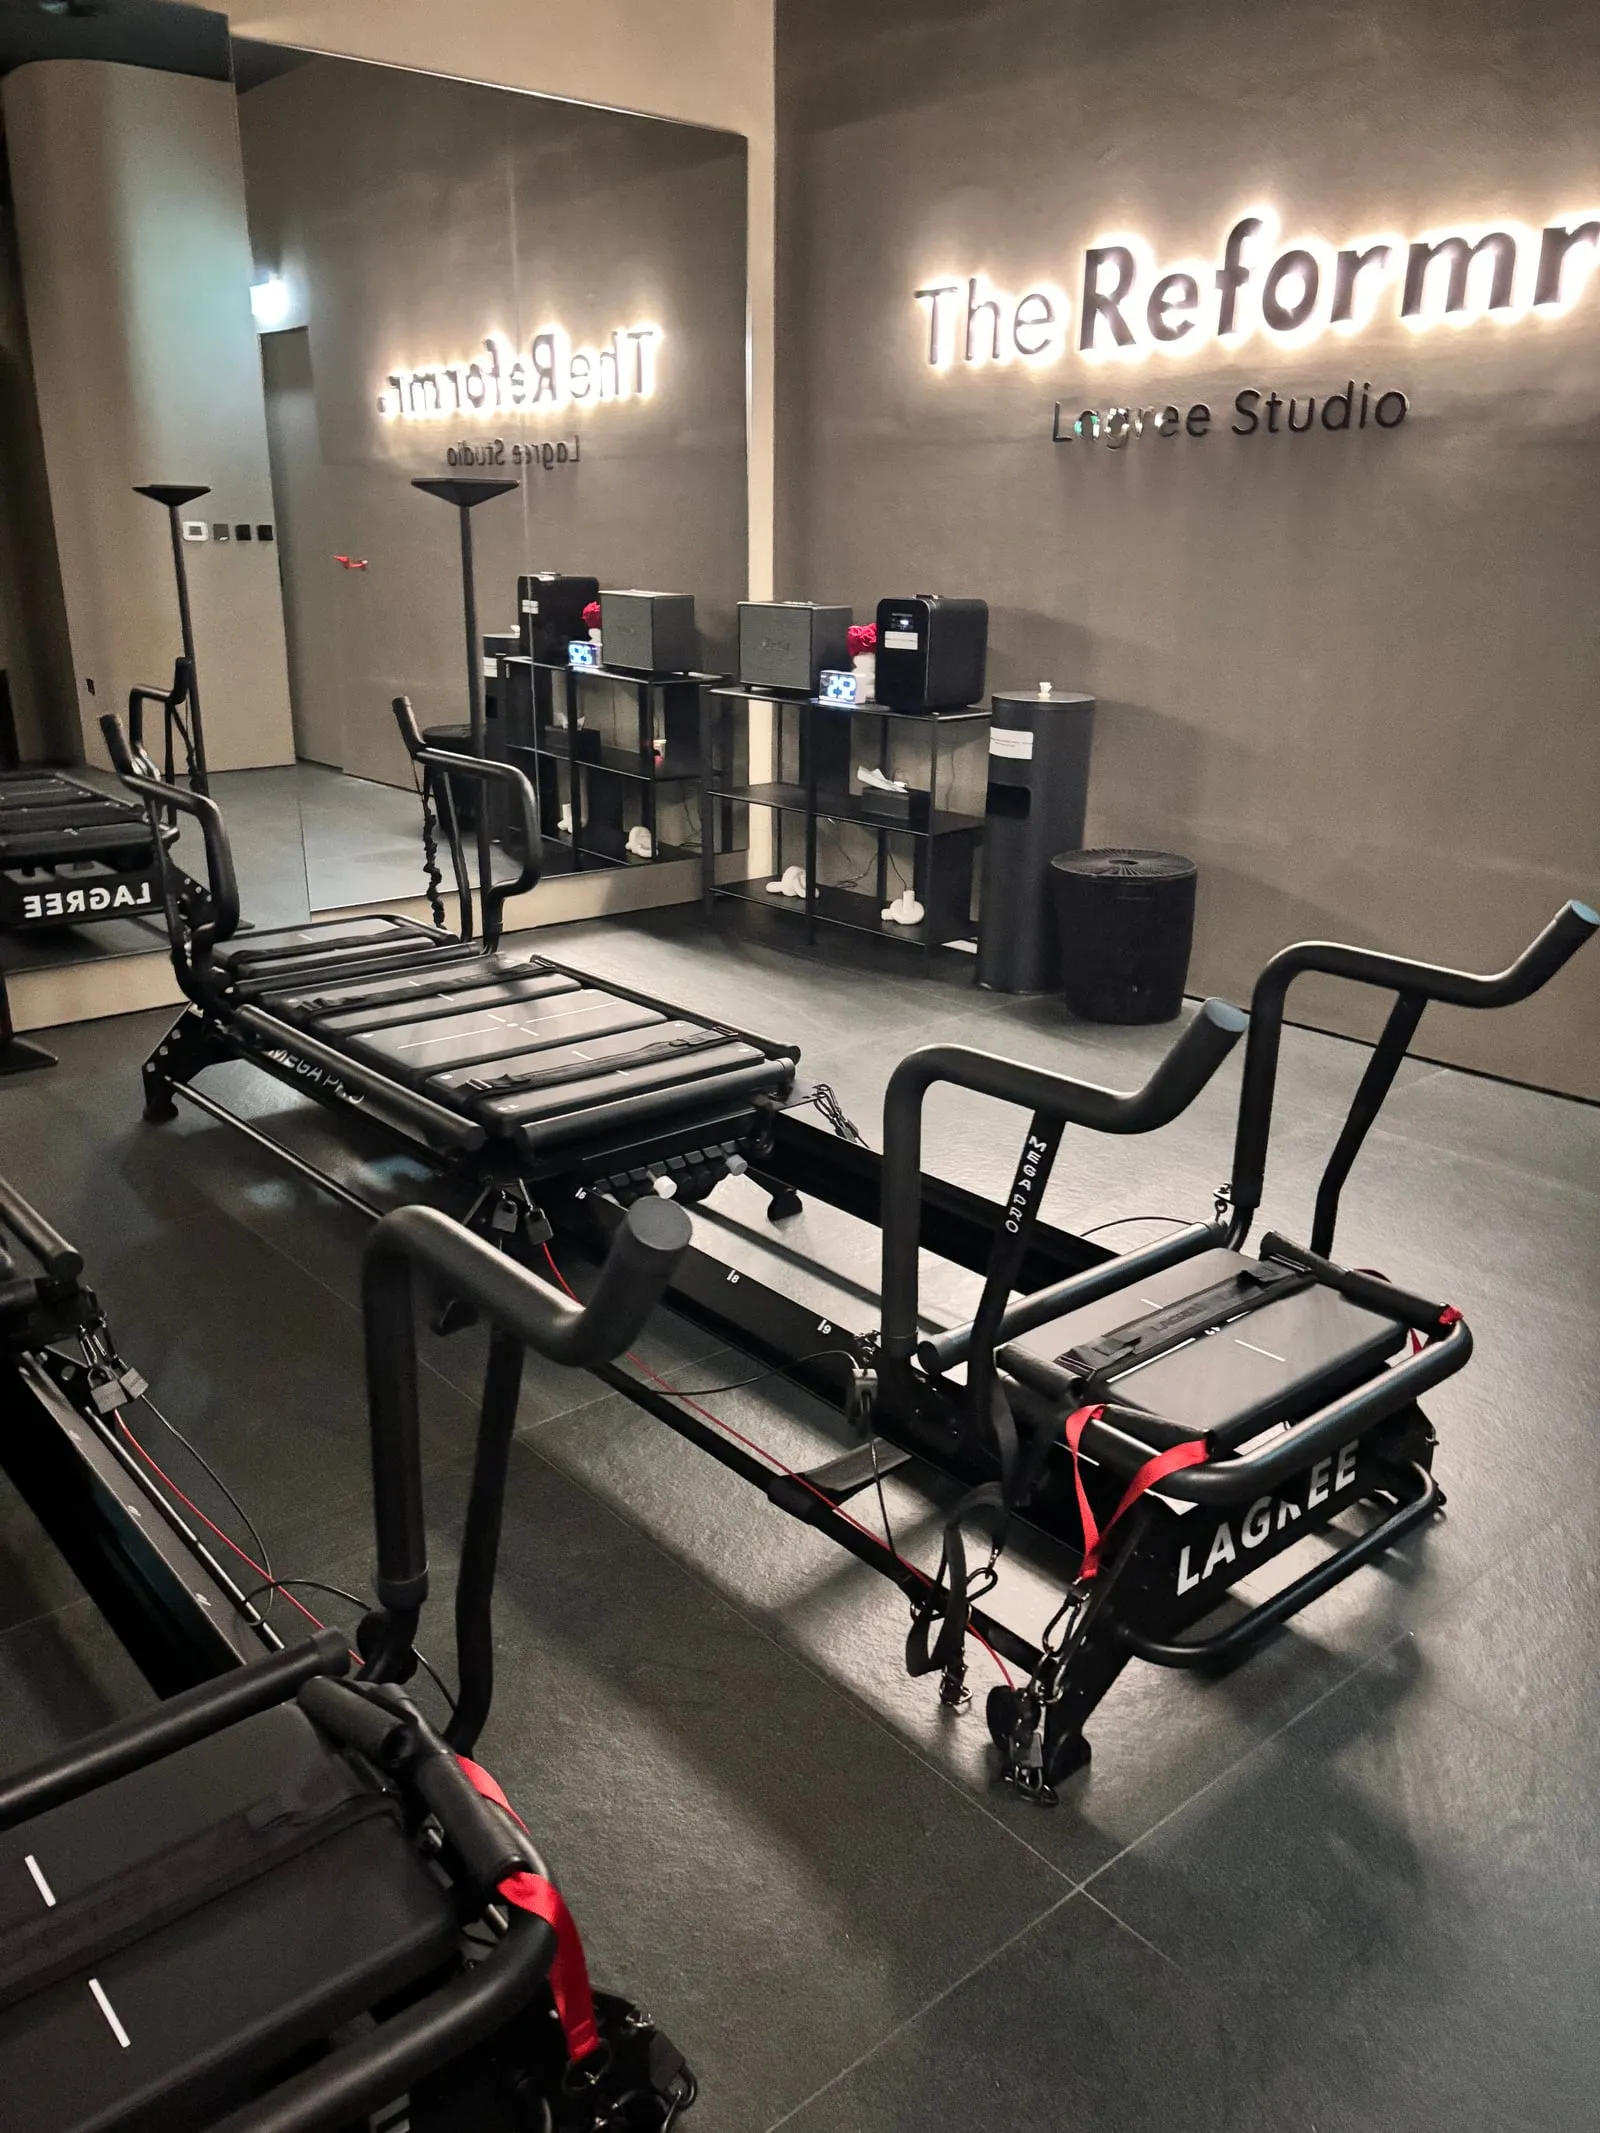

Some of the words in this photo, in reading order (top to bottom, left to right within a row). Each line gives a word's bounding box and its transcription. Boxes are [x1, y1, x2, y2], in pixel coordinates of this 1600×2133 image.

[914, 278, 1056, 367] The
[1079, 215, 1600, 351] Reformr
[1052, 400, 1211, 450] Lagree
[1231, 380, 1411, 436] Studio
[1018, 1136, 1047, 1192] MEGA
[1005, 1194, 1028, 1234] PRO
